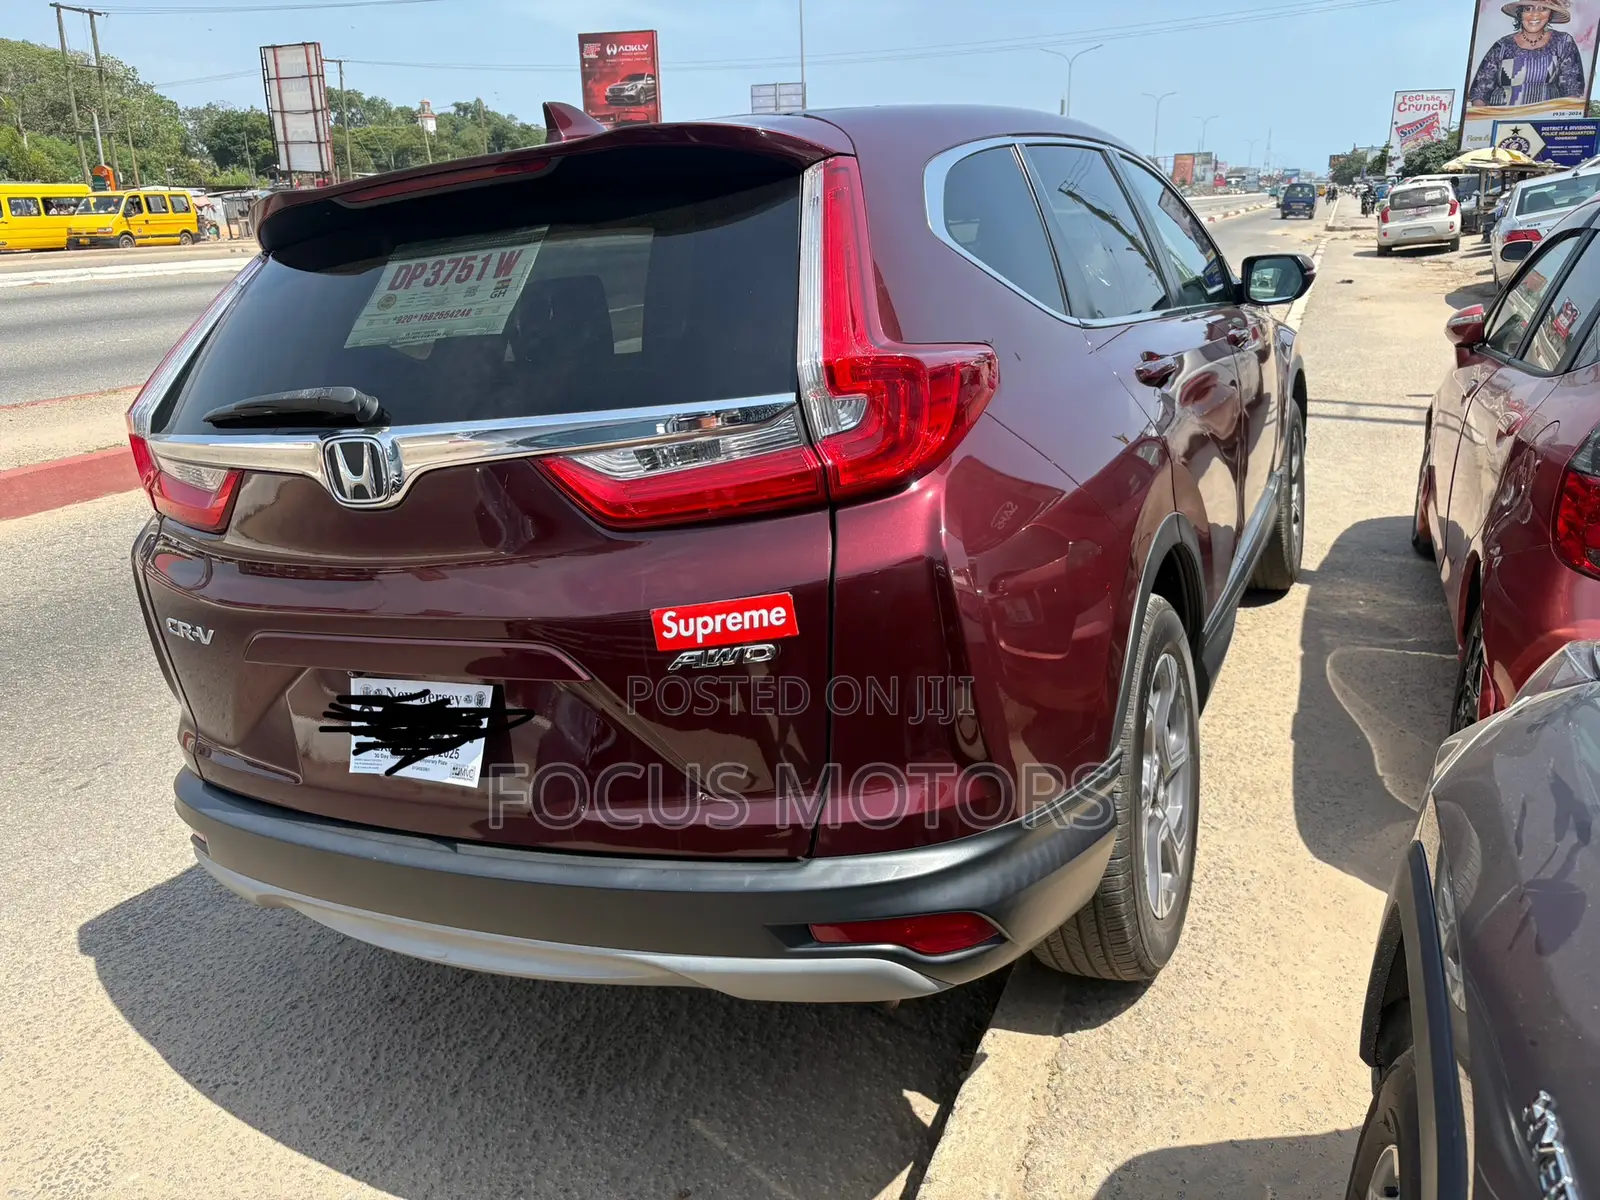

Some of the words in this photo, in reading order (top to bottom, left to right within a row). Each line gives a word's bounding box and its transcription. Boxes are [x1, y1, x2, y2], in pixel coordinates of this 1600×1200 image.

[1397, 100, 1452, 113] Crunch!
[490, 289, 507, 300] GH
[166, 616, 215, 646] CR-V
[661, 606, 787, 643] Supreme
[667, 643, 777, 671] AWD
